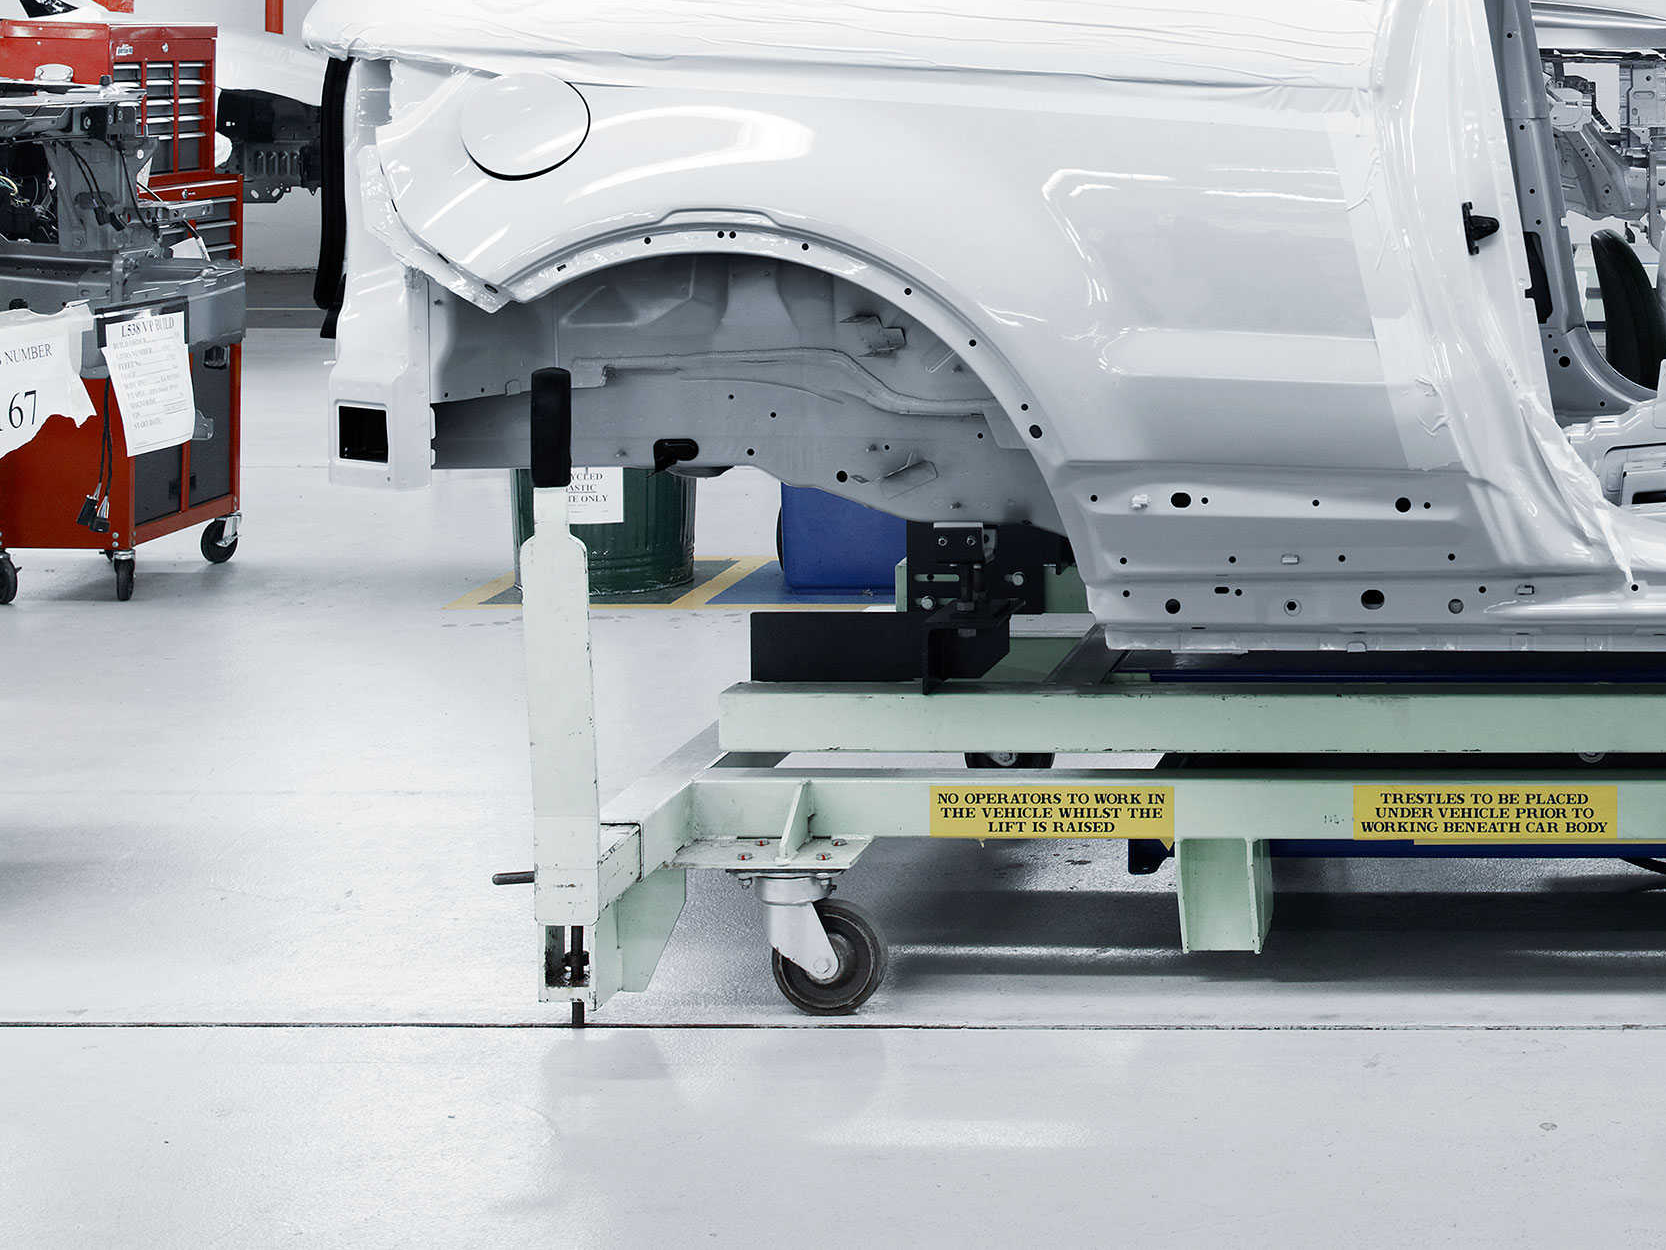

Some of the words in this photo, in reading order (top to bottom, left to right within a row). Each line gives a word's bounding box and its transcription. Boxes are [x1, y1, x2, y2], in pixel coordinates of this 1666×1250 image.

[4, 343, 53, 365] NUMBER
[0, 388, 37, 432] 67
[581, 494, 608, 503] ONLY
[937, 792, 959, 805] NO
[964, 792, 1062, 805] OPERATORS
[1066, 792, 1090, 805] TO
[1094, 792, 1142, 805] WORK
[1147, 792, 1166, 805] IN
[1380, 792, 1465, 805] TRESTLES
[1470, 792, 1493, 805] TO
[1497, 792, 1520, 805] BE
[1525, 792, 1589, 805] PLACED
[940, 807, 976, 819] THE
[982, 807, 1053, 819] VEHICLE
[1058, 807, 1122, 819] WHILST
[1127, 807, 1163, 819] THE
[1375, 807, 1434, 819] UNDER
[1438, 807, 1510, 819] VEHICLE
[1515, 807, 1568, 819] PRIOR
[1571, 807, 1595, 819] TO
[988, 821, 1027, 833] LIFT
[1032, 821, 1047, 833] IS
[1052, 821, 1115, 833] RAISED
[1360, 821, 1439, 833] WORKING
[1443, 821, 1521, 833] BENEATH
[1525, 821, 1559, 833] CAR
[1565, 821, 1608, 834] BODY
